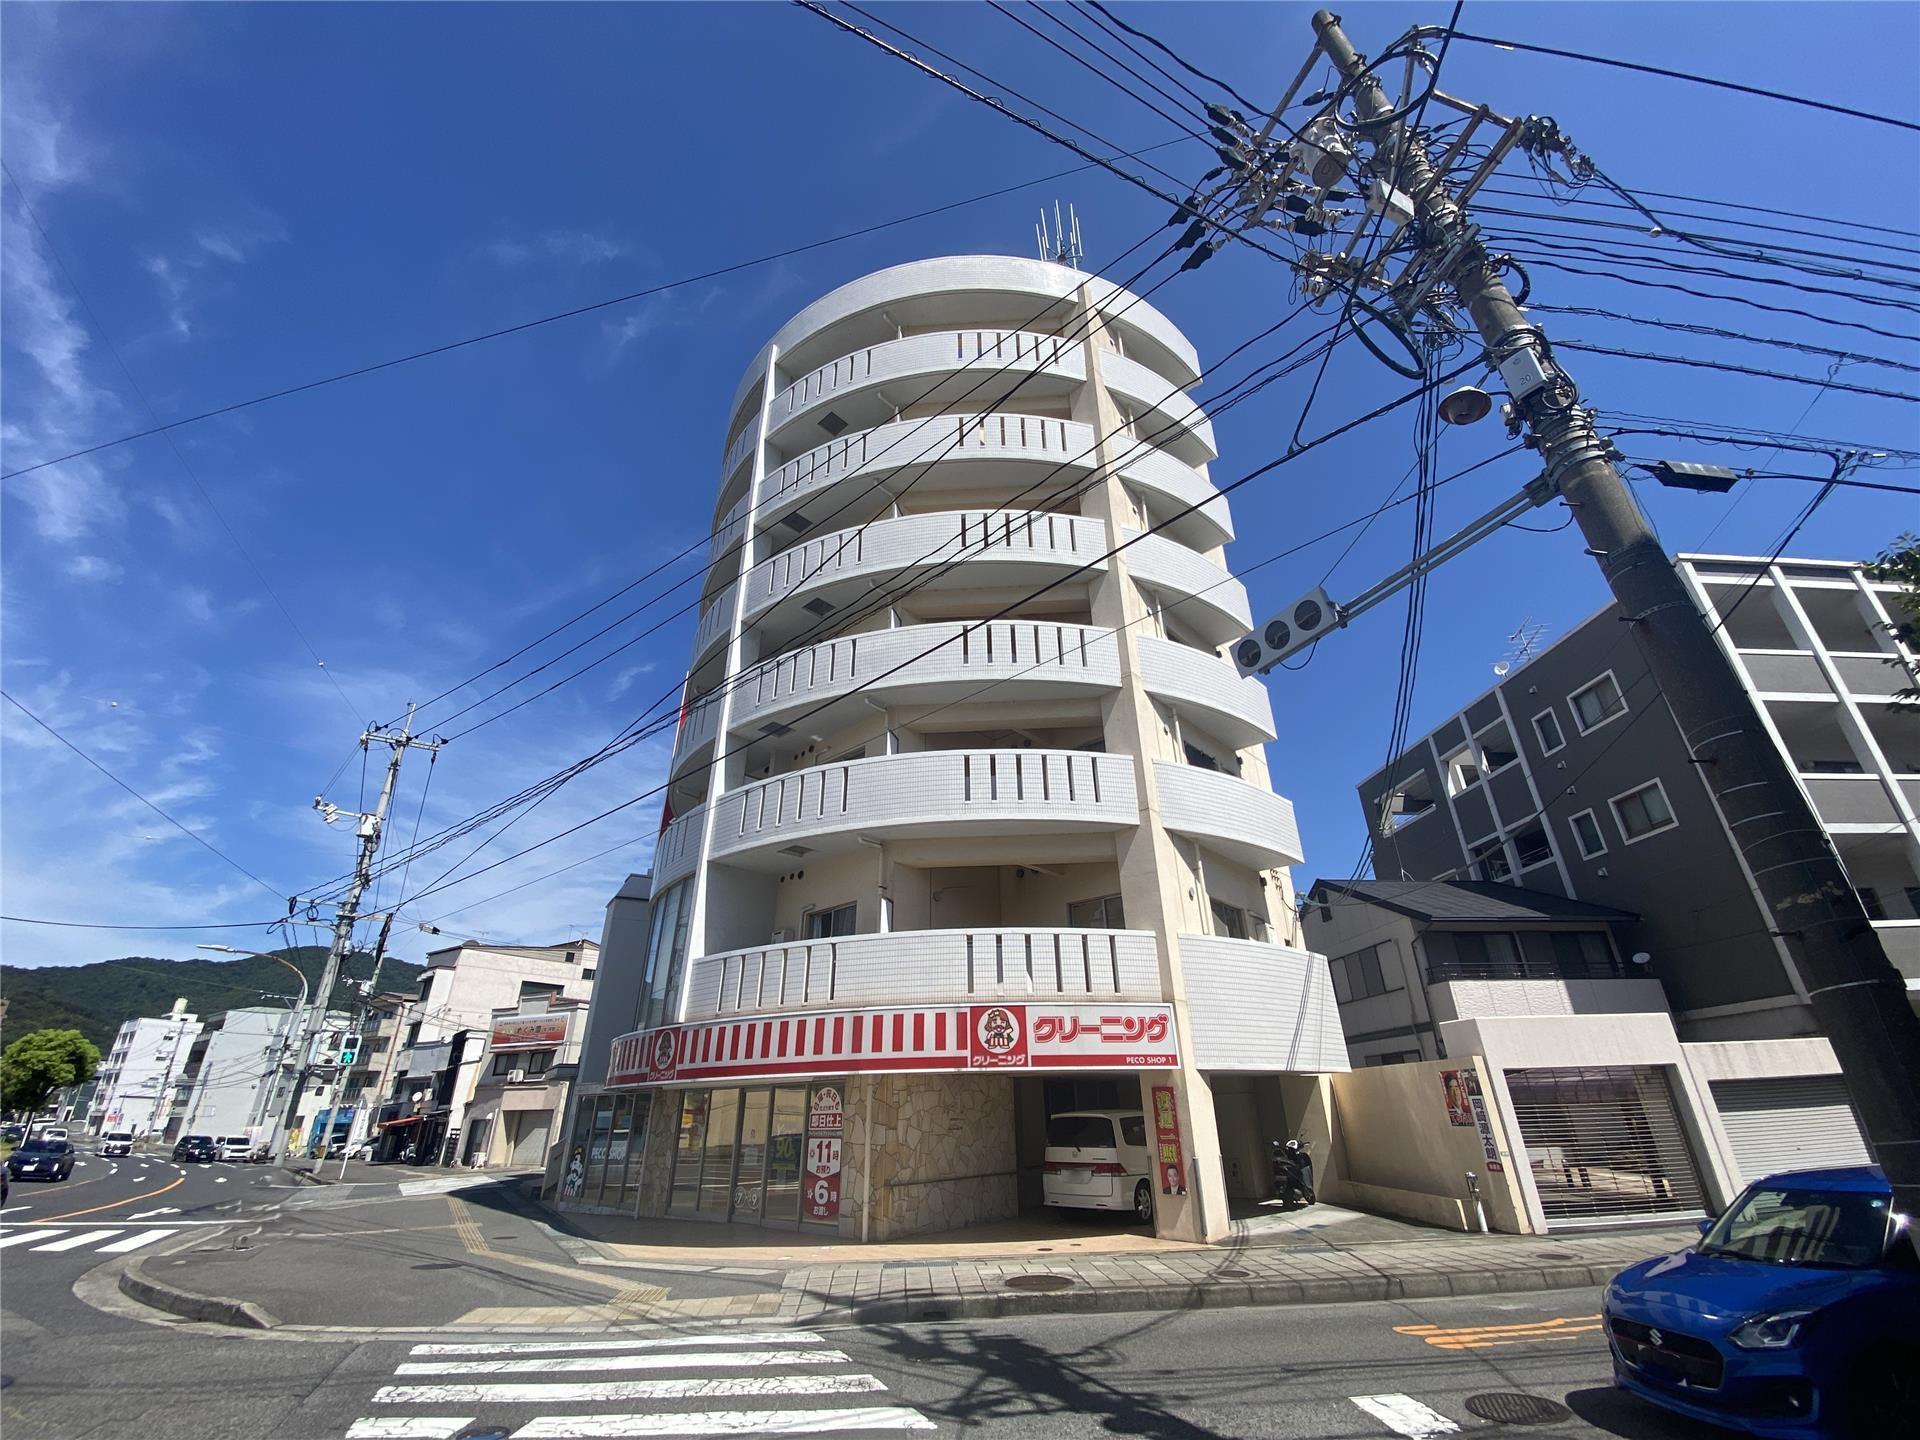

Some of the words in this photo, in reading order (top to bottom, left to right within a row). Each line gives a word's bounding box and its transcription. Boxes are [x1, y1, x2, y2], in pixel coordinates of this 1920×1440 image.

[1033, 1013, 1169, 1043] クリーニング
[972, 1053, 1026, 1067] クリーニング
[1126, 1056, 1145, 1064] PECO
[1147, 1056, 1166, 1064] SHOP
[649, 1069, 675, 1080] クリーニング
[811, 1114, 842, 1128] 即日仕上
